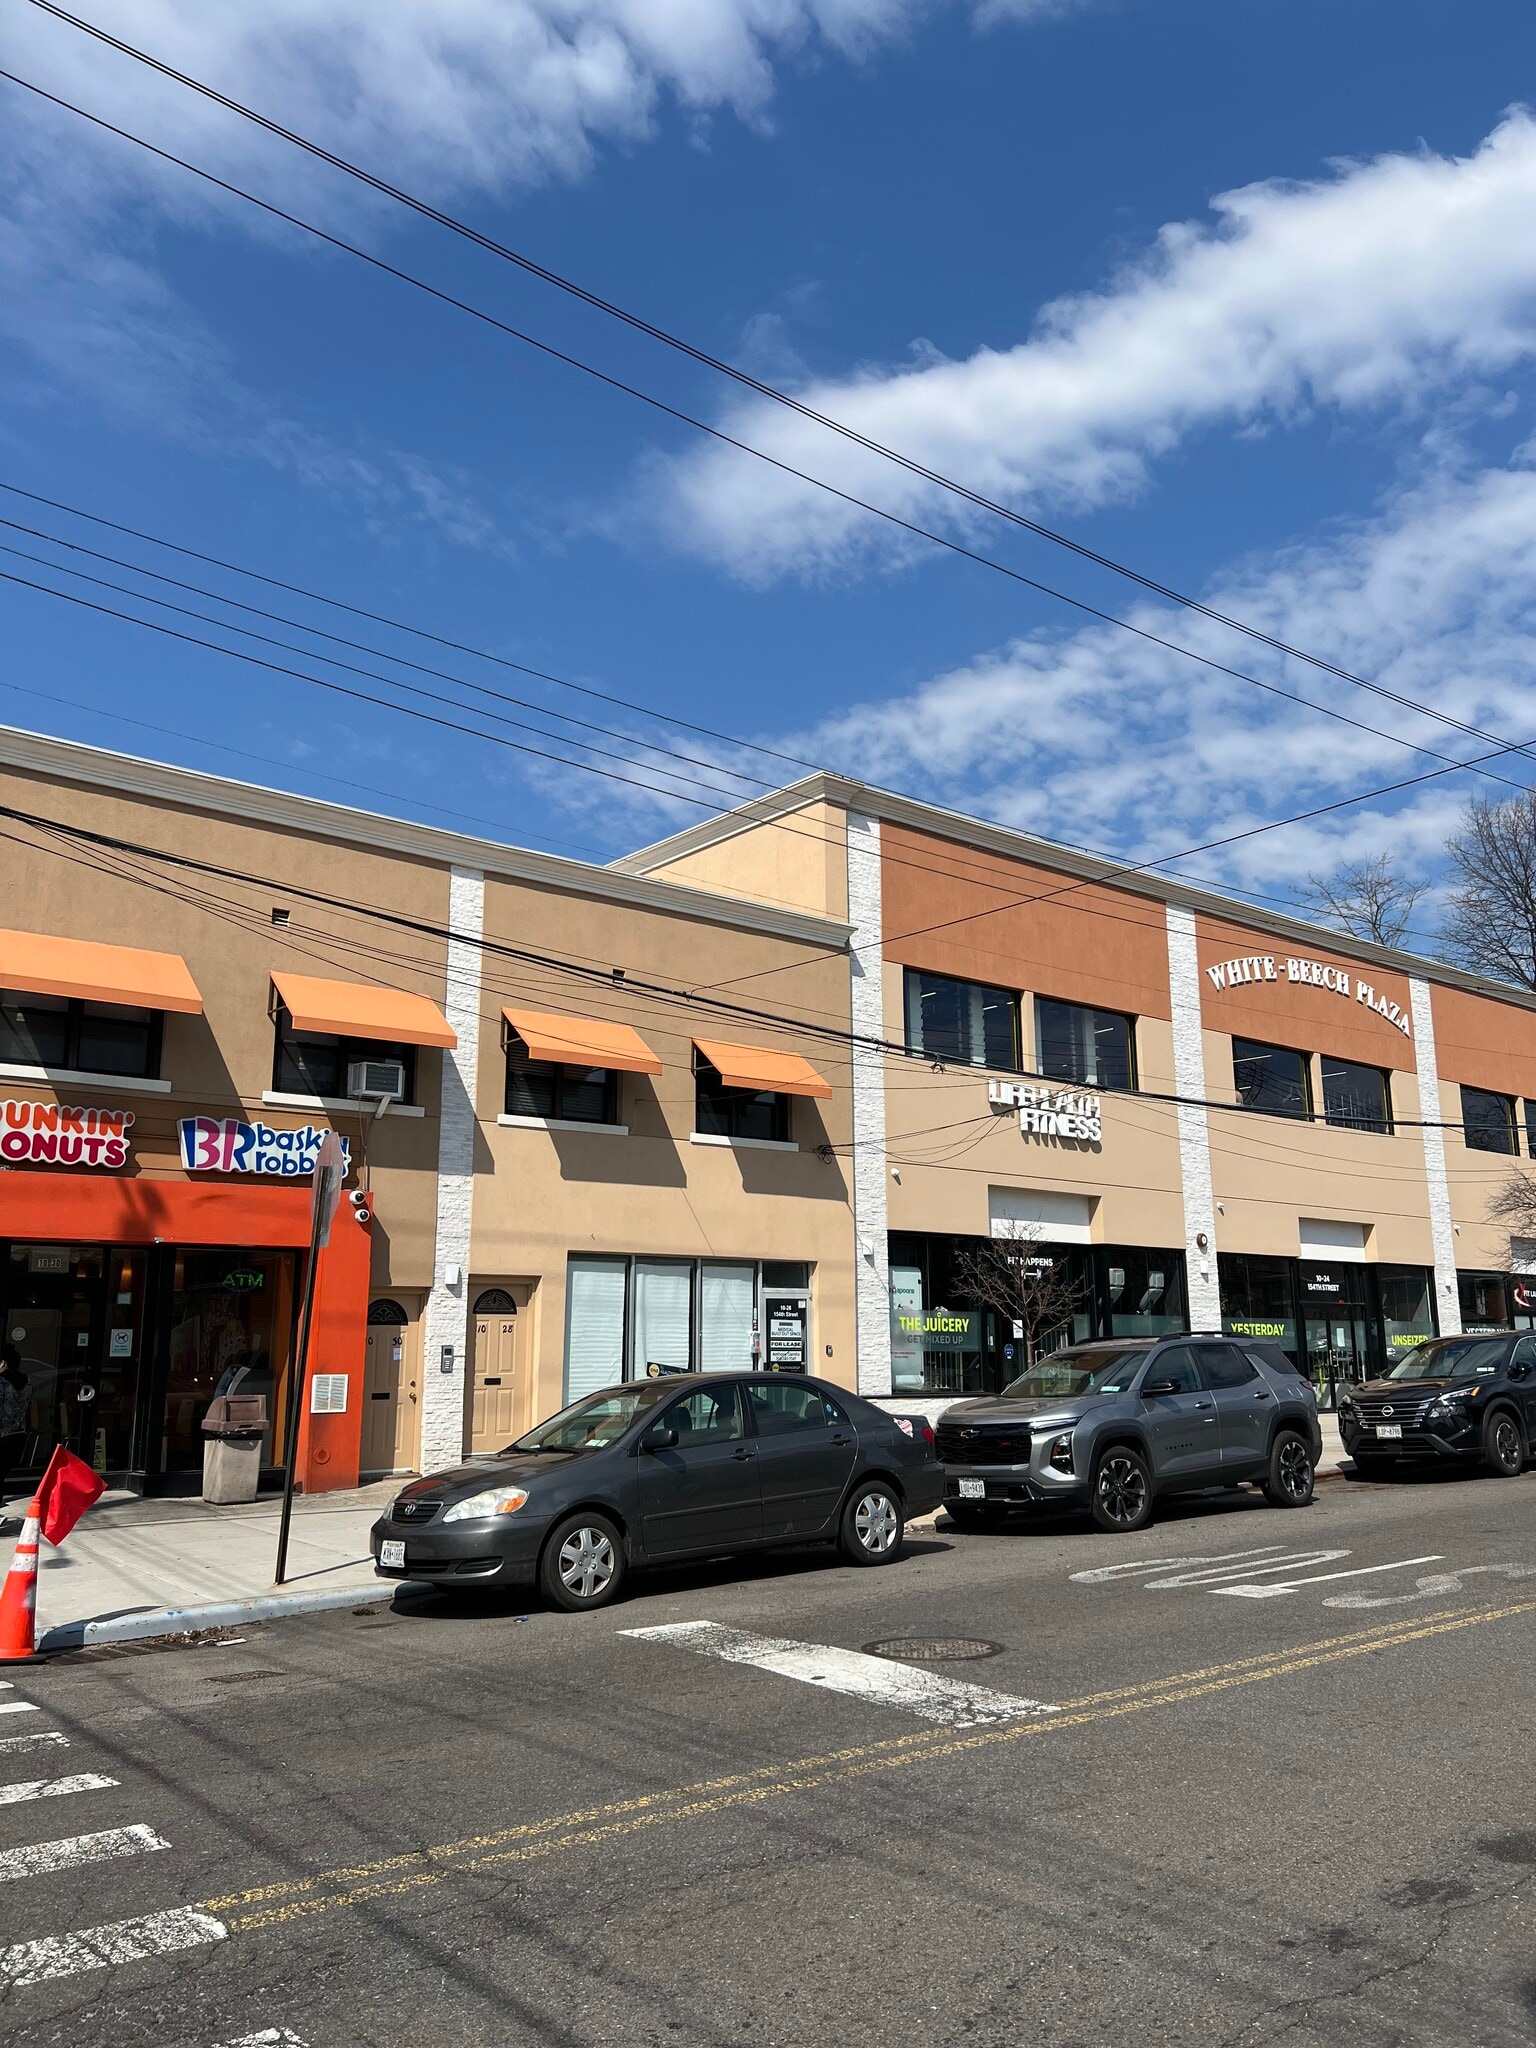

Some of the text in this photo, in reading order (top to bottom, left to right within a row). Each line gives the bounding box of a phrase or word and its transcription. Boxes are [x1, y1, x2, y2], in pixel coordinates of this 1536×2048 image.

[1205, 956, 1411, 1038] WHITE-BEECH PLAZA
[0, 1102, 134, 1137] UNKIN'
[1020, 1108, 1102, 1142] FITNESS
[0, 1131, 125, 1166] ONUTS
[257, 1123, 349, 1156] bask
[256, 1151, 347, 1177] robb
[1020, 1257, 1053, 1266] HAPPENS
[222, 1273, 264, 1287] ATM
[477, 1324, 513, 1334] 10 28
[899, 1312, 969, 1332] THE JUICERY
[1230, 1323, 1285, 1336] YESTERDAY
[907, 1335, 964, 1344] GET MIXED UP
[1069, 1545, 1536, 1608] STOP
